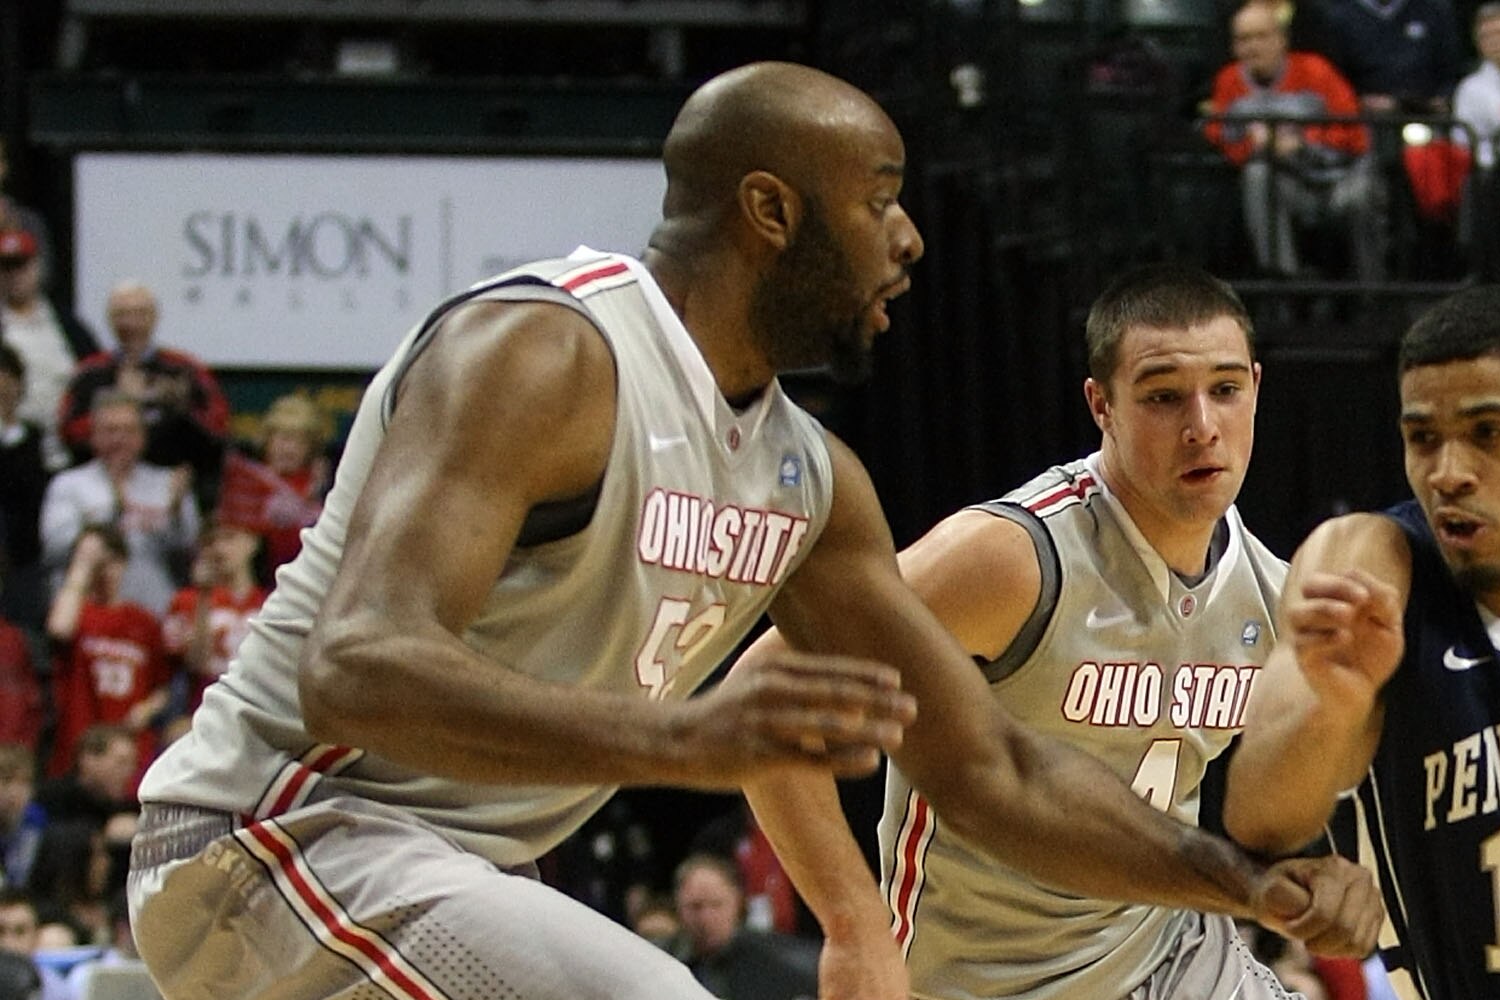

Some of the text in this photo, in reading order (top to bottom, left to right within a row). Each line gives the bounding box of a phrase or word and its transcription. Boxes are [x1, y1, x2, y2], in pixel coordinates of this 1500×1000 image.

[181, 208, 413, 281] SIMON
[1061, 660, 1263, 730] OHIO STAT
